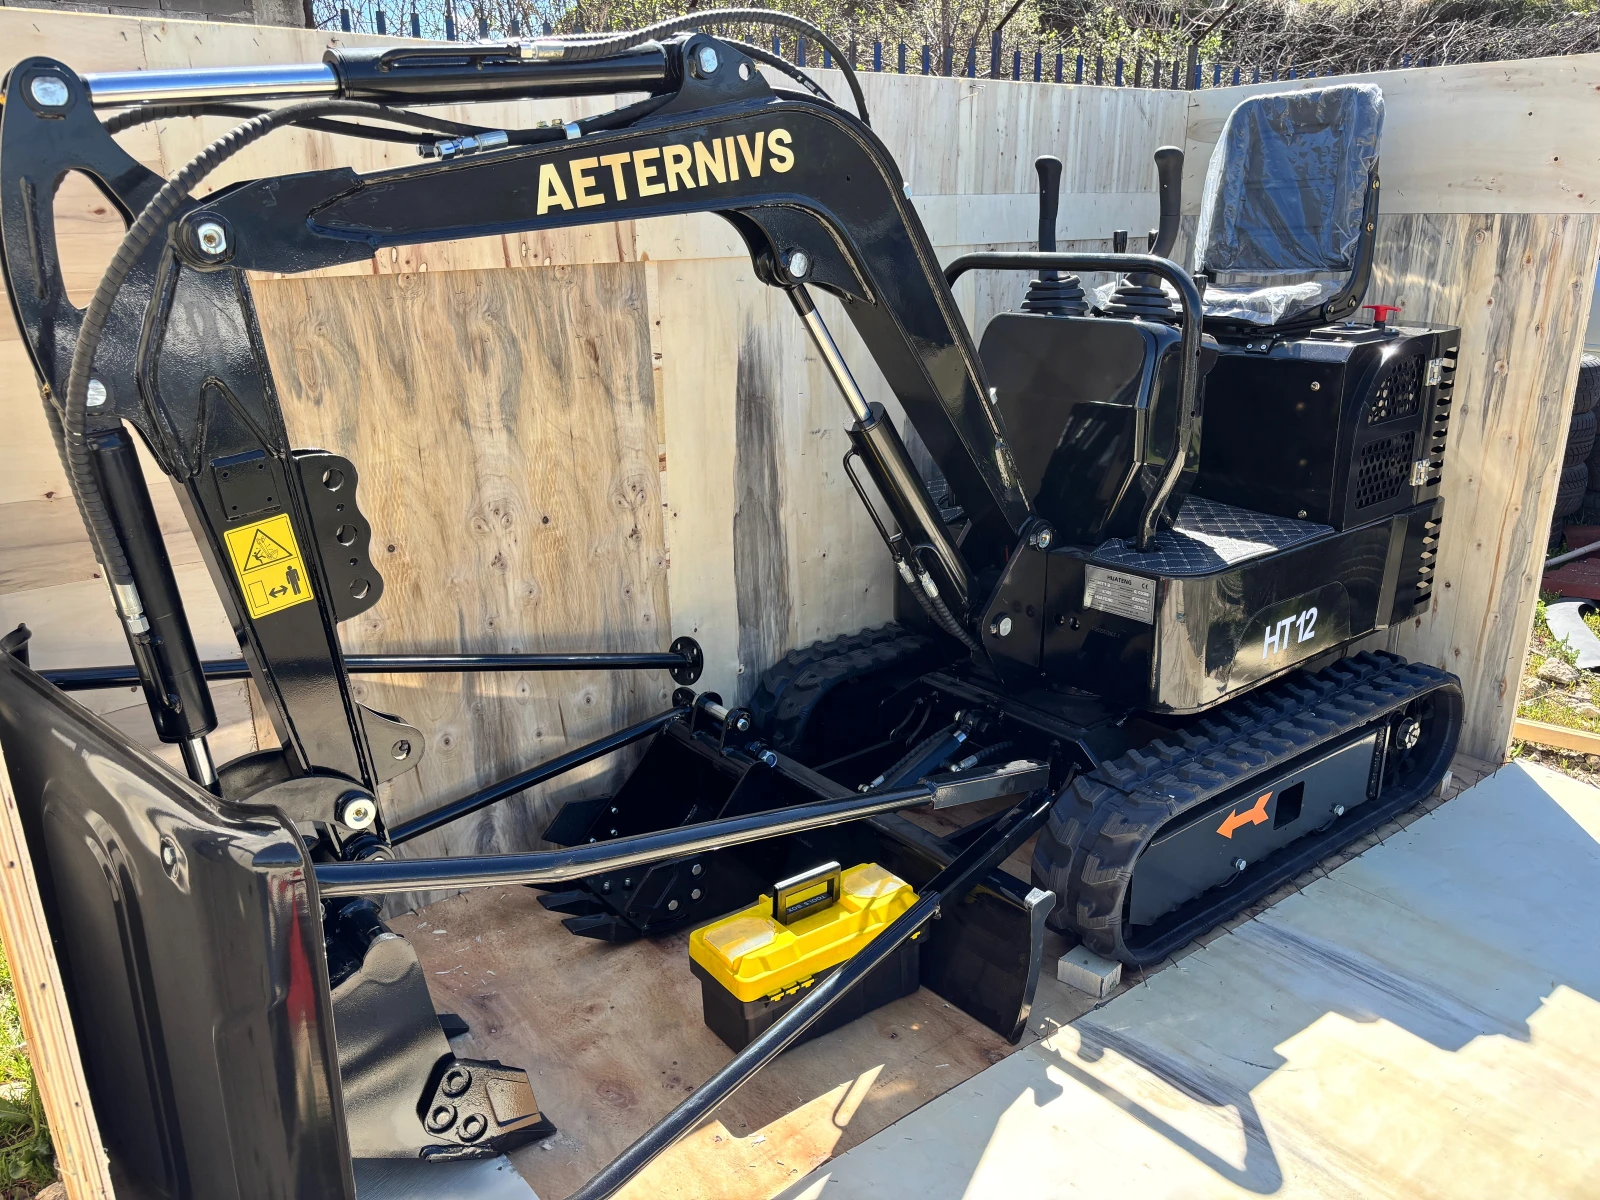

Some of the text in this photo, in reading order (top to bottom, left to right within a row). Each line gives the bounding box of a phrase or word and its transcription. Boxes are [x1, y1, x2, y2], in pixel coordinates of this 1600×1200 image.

[537, 128, 795, 216] AETERNIVS
[1107, 575, 1132, 585] HUATENG
[1263, 607, 1318, 659] HT12
[787, 896, 826, 913] TOOLS BOX
